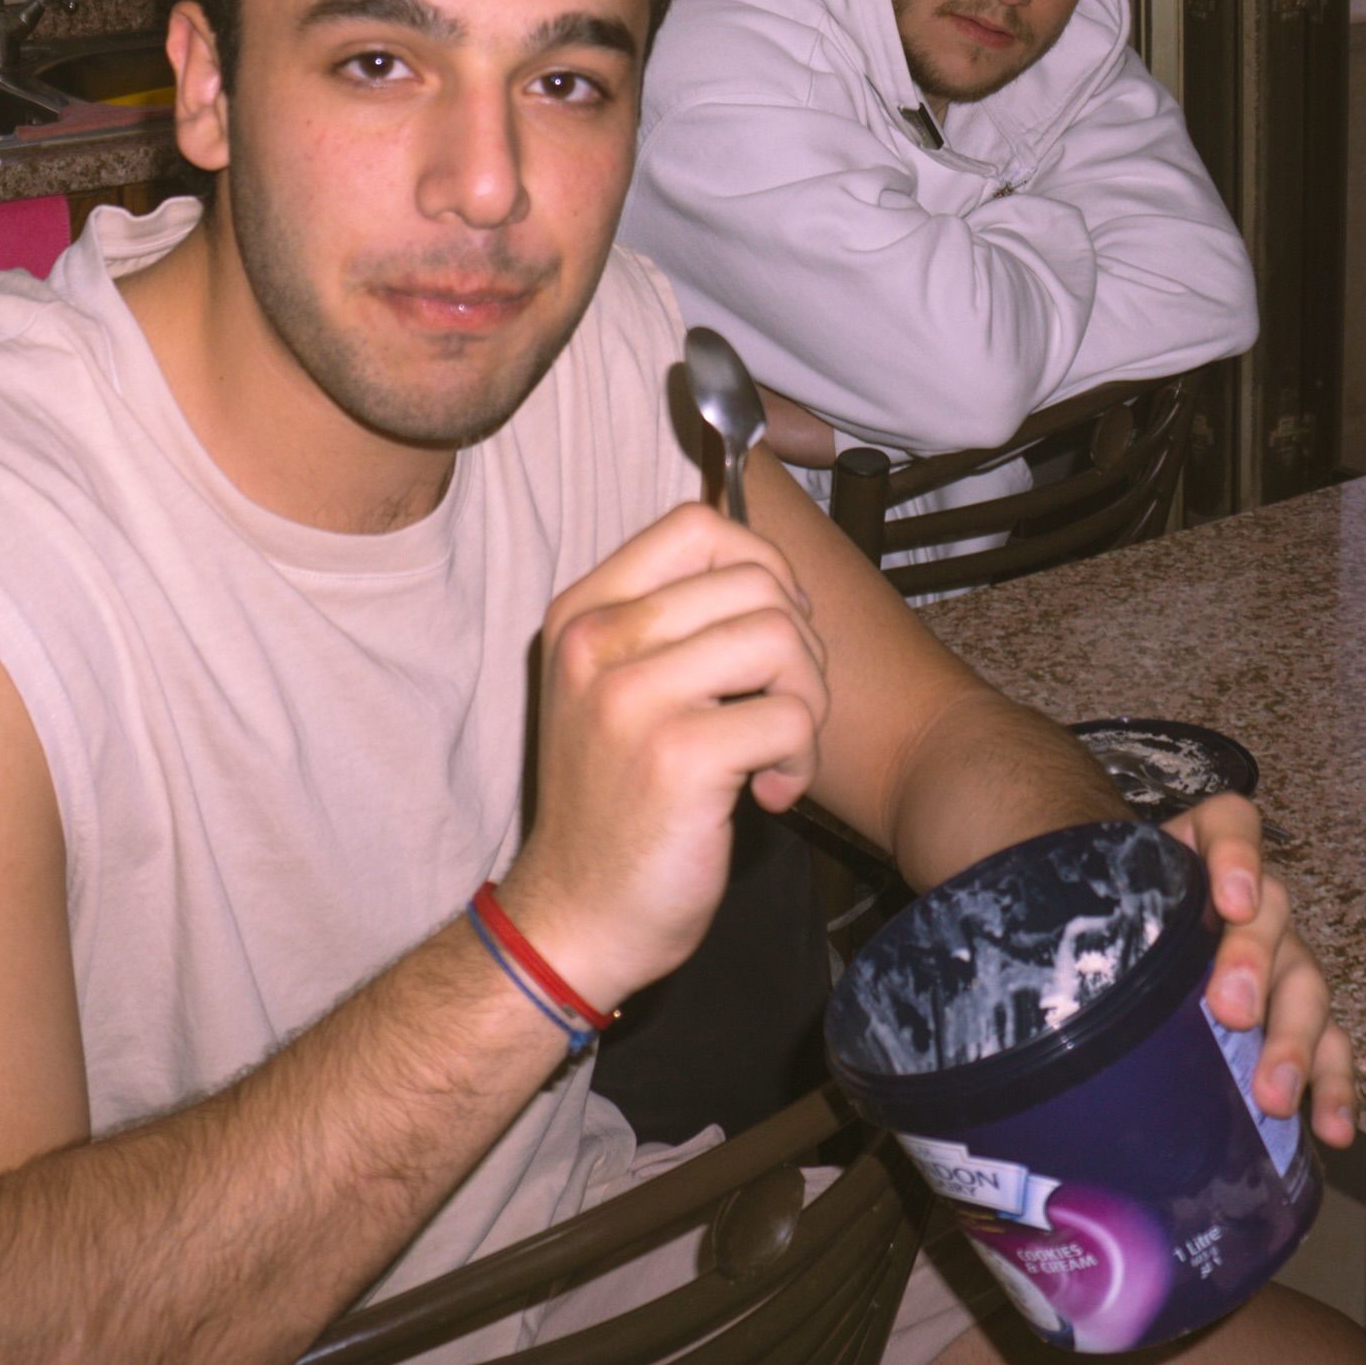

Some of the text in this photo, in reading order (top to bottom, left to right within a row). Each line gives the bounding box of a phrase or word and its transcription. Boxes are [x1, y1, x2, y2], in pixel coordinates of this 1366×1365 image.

[1184, 1224, 1223, 1257] Litre
[1016, 1242, 1084, 1262] COOKIES
[1024, 1253, 1099, 1275] & CREAM
